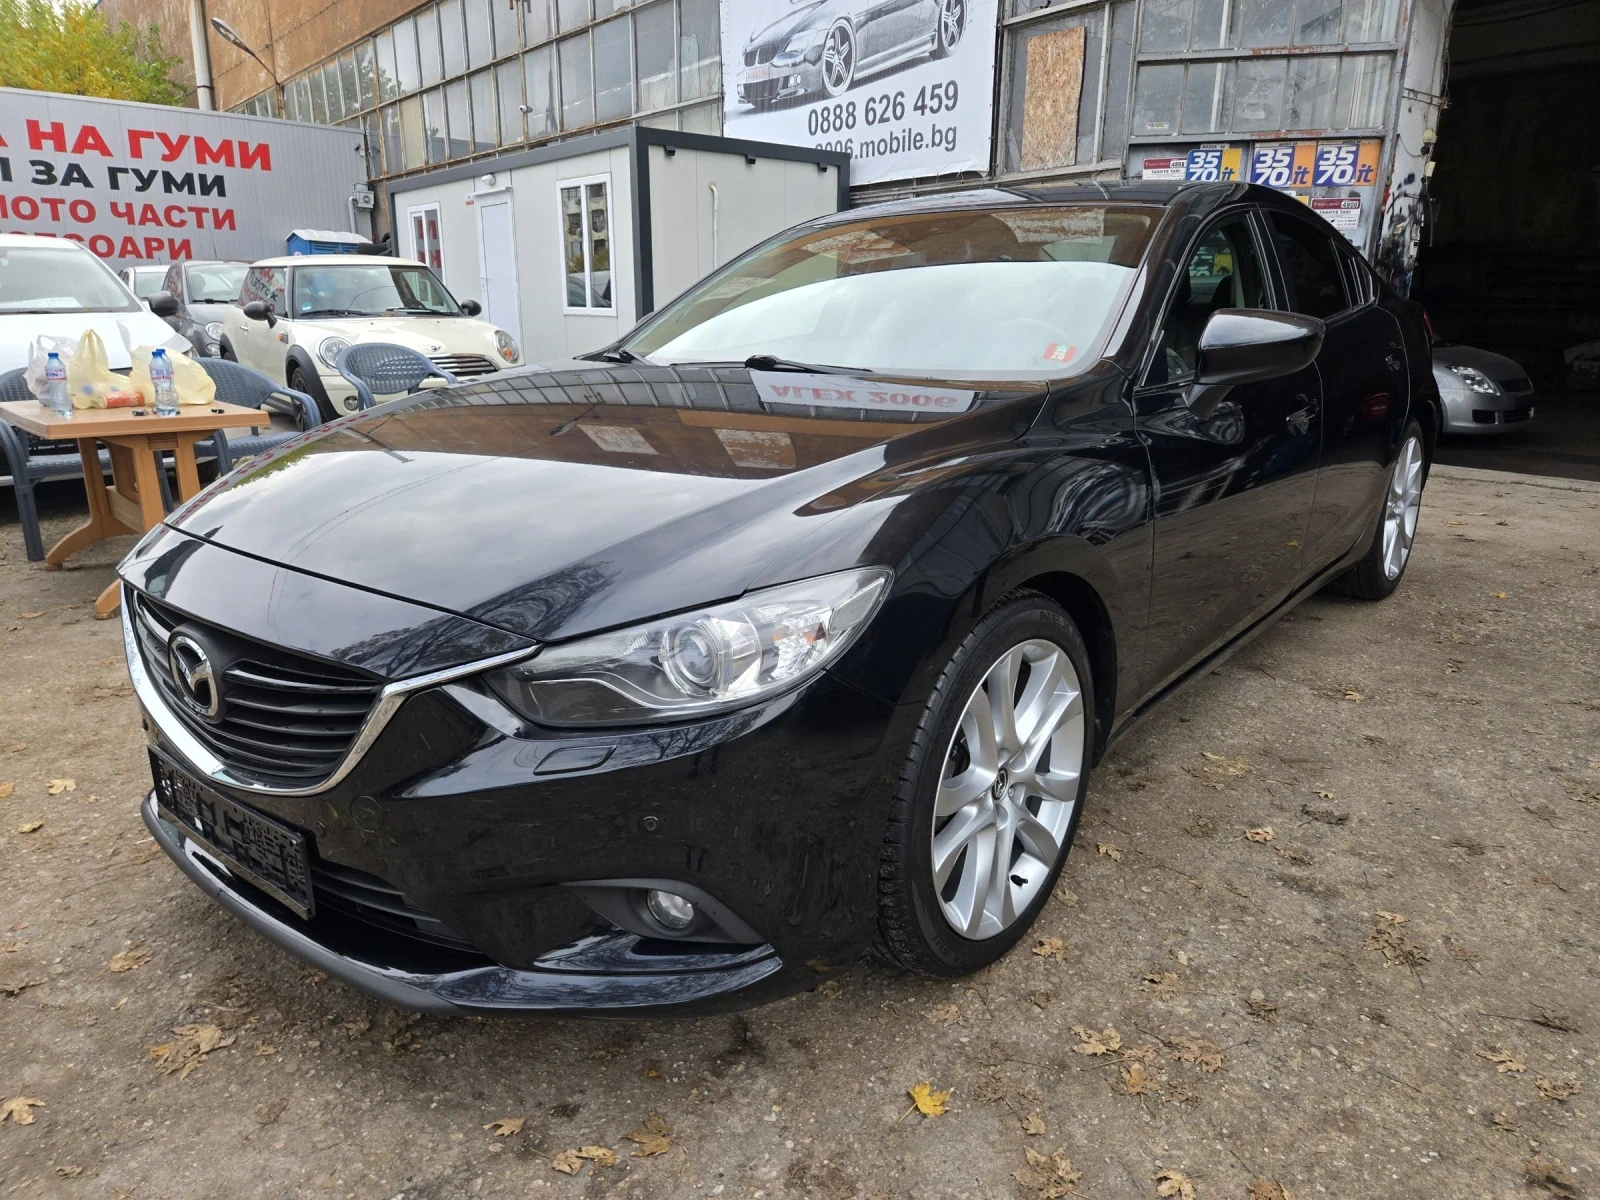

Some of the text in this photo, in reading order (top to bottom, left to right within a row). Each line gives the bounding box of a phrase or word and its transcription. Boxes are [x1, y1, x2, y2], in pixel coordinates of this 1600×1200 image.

[808, 79, 959, 136] 0888 626 459
[26, 118, 272, 171] НА ГУМИ
[1190, 152, 1220, 168] 35
[1255, 148, 1293, 168] 35
[1318, 146, 1357, 165] 35
[28, 160, 95, 188] ЗА
[107, 165, 227, 198] ГУМИ
[0, 194, 236, 231] ОТО ЧАСТИ
